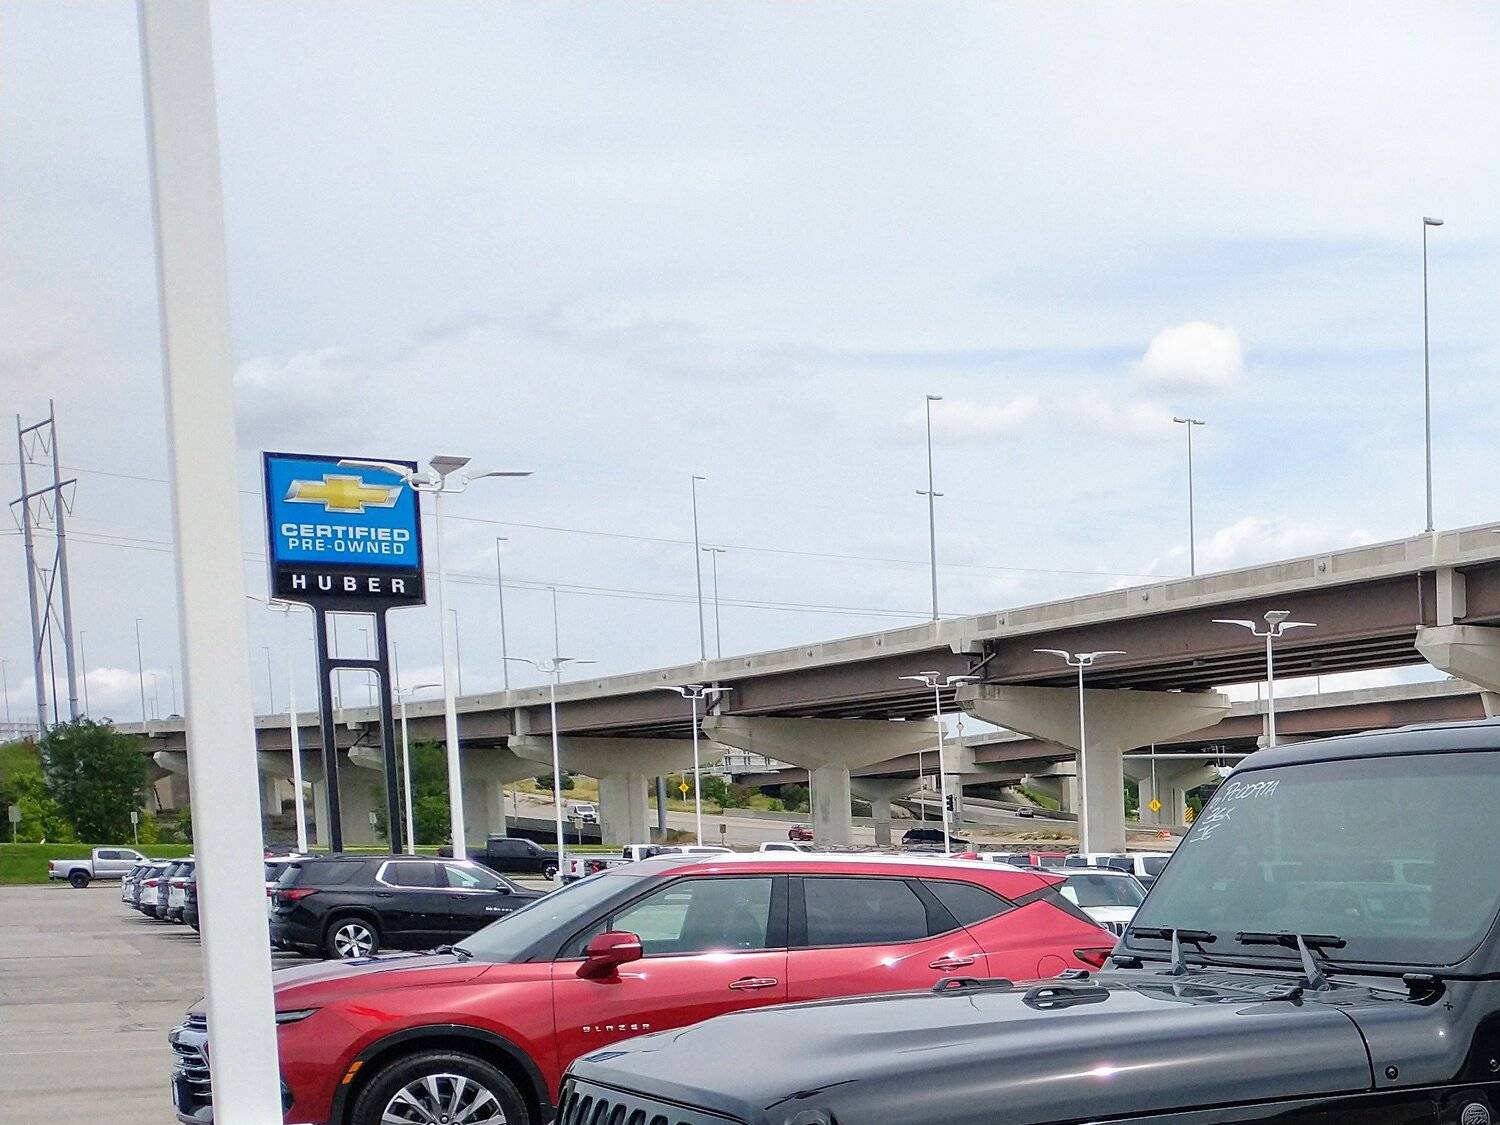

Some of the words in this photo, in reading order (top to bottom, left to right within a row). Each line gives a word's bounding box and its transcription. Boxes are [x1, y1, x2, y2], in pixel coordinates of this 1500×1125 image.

[281, 523, 410, 542] CERTIFIED
[288, 538, 405, 555] PRE-OWNED
[292, 574, 406, 594] HUBER
